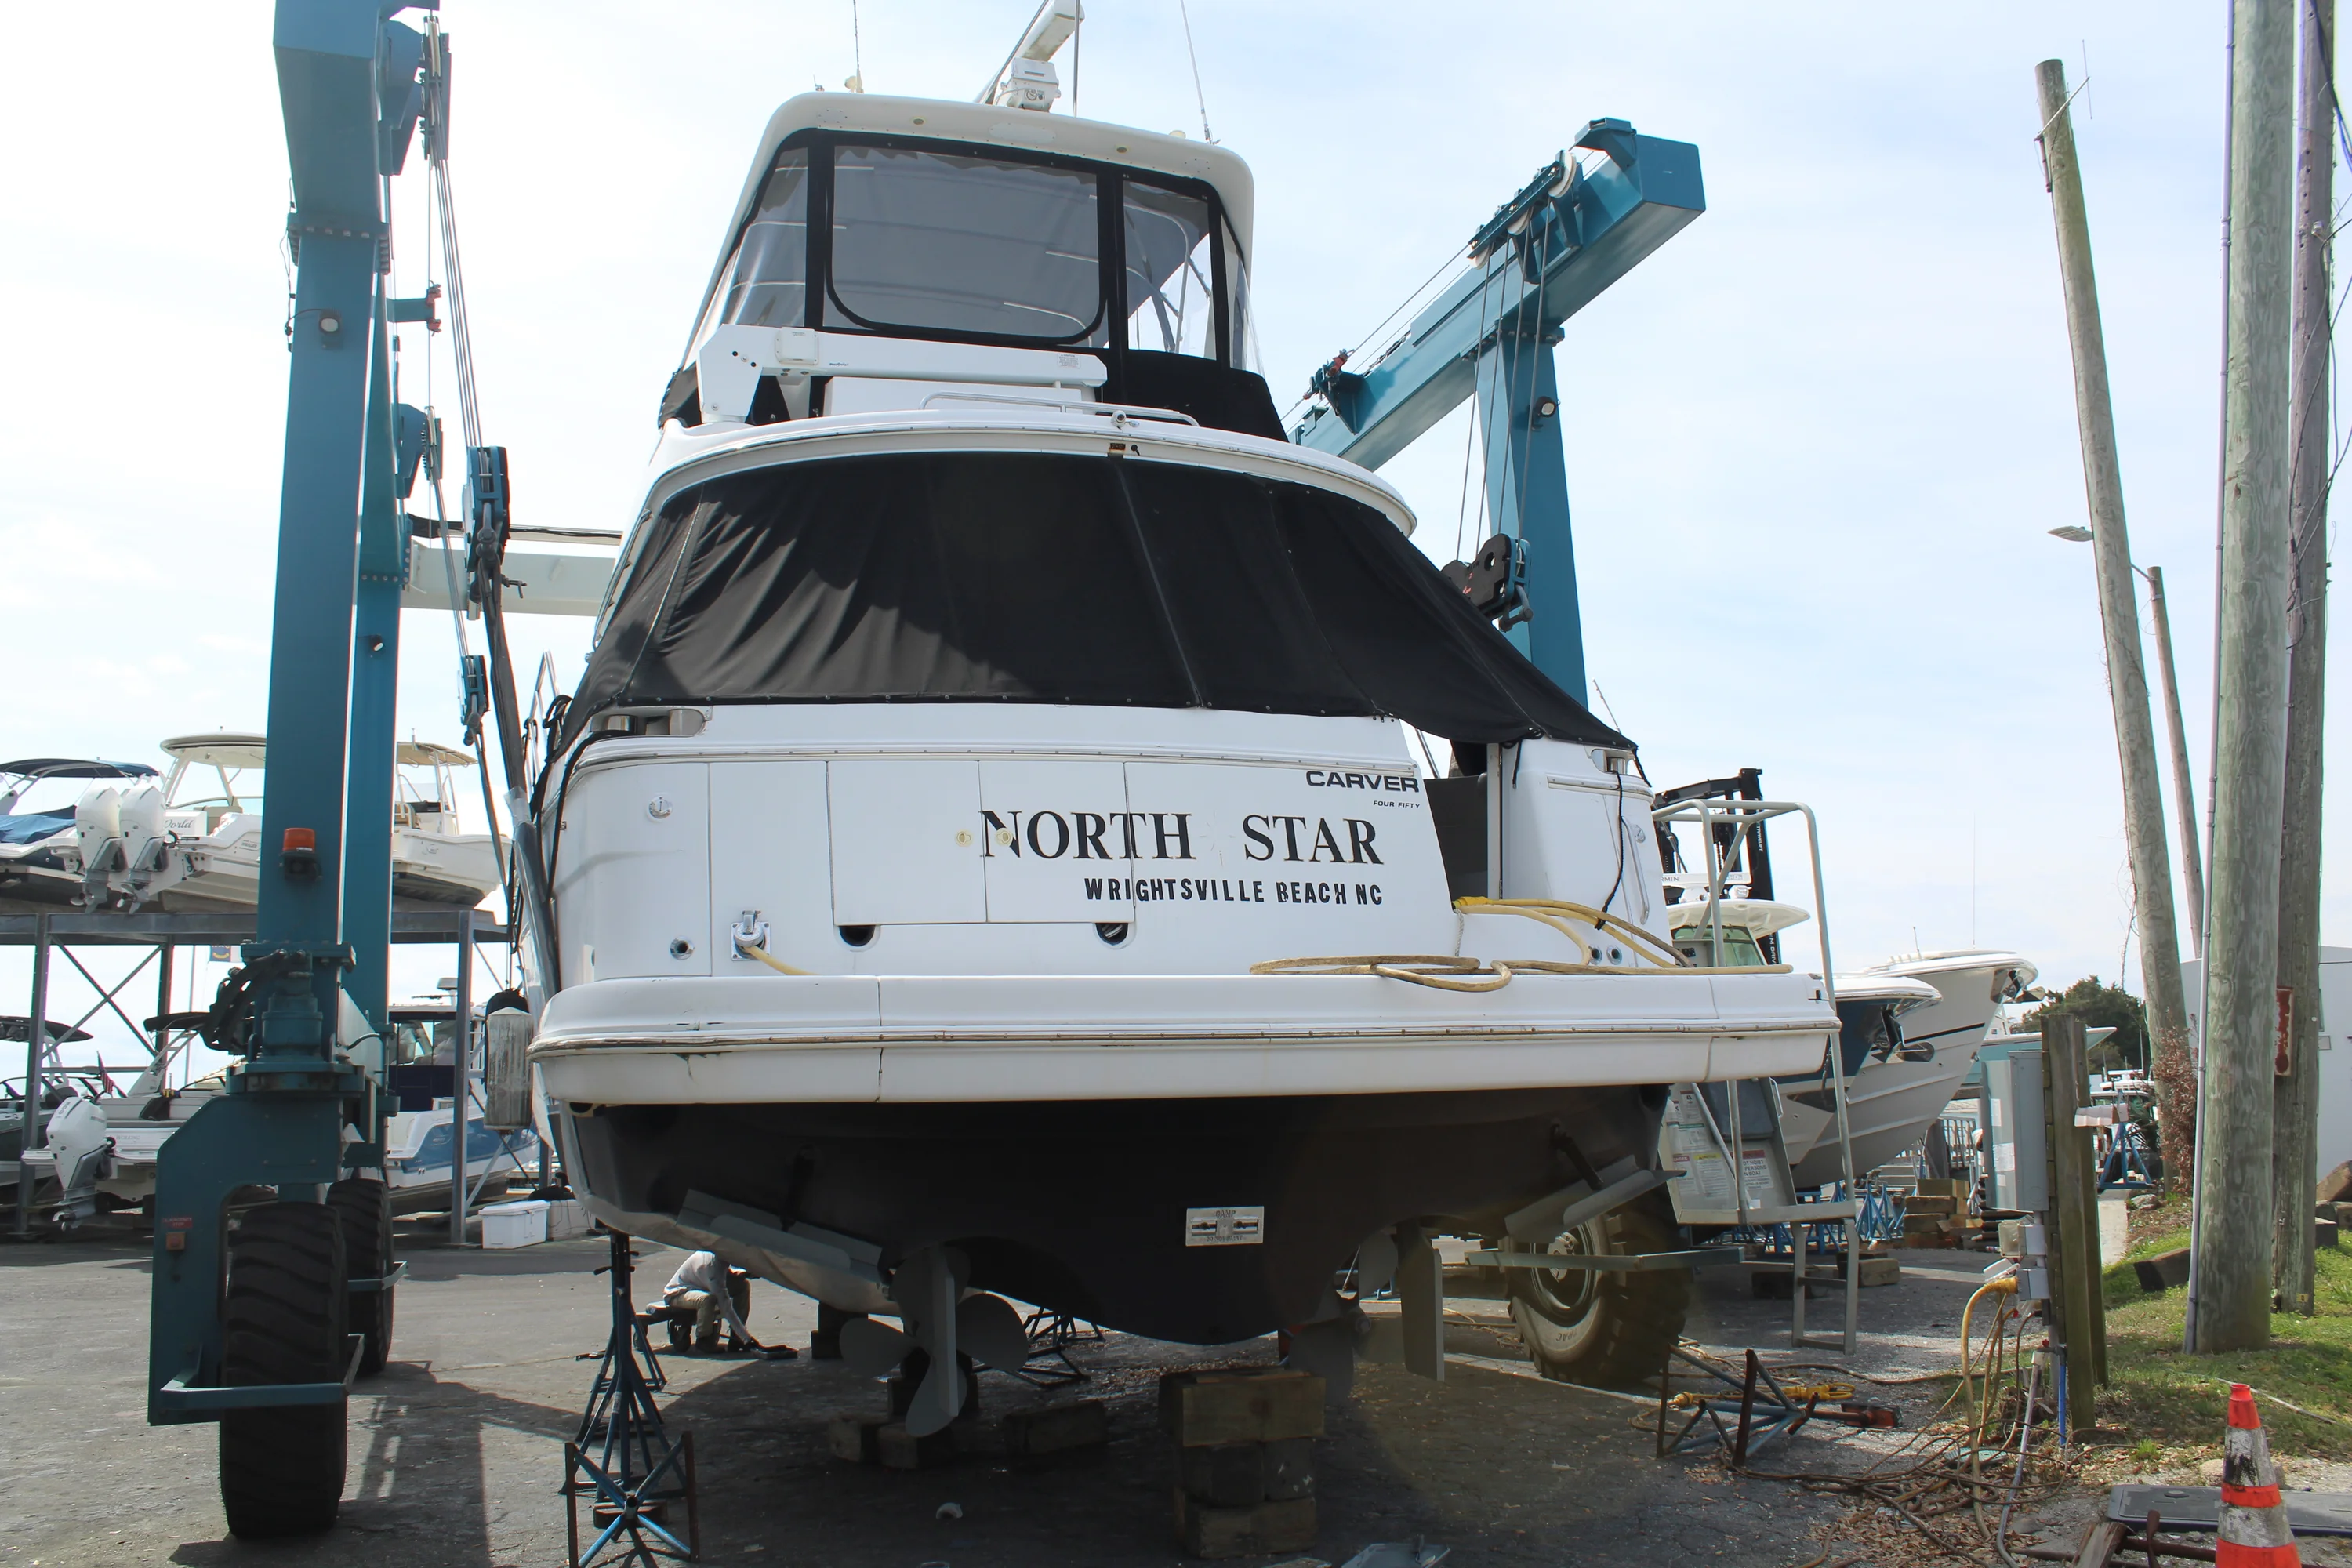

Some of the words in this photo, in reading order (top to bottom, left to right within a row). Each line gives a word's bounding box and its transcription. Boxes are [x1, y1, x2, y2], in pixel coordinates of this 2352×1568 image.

[1306, 771, 1419, 793] CARVER
[982, 810, 1197, 861] NORTH
[1243, 814, 1384, 866] STAR
[1084, 877, 1265, 903] WRIGHTSVILLE
[1276, 882, 1347, 905] BEACH
[1356, 884, 1383, 906] NC
